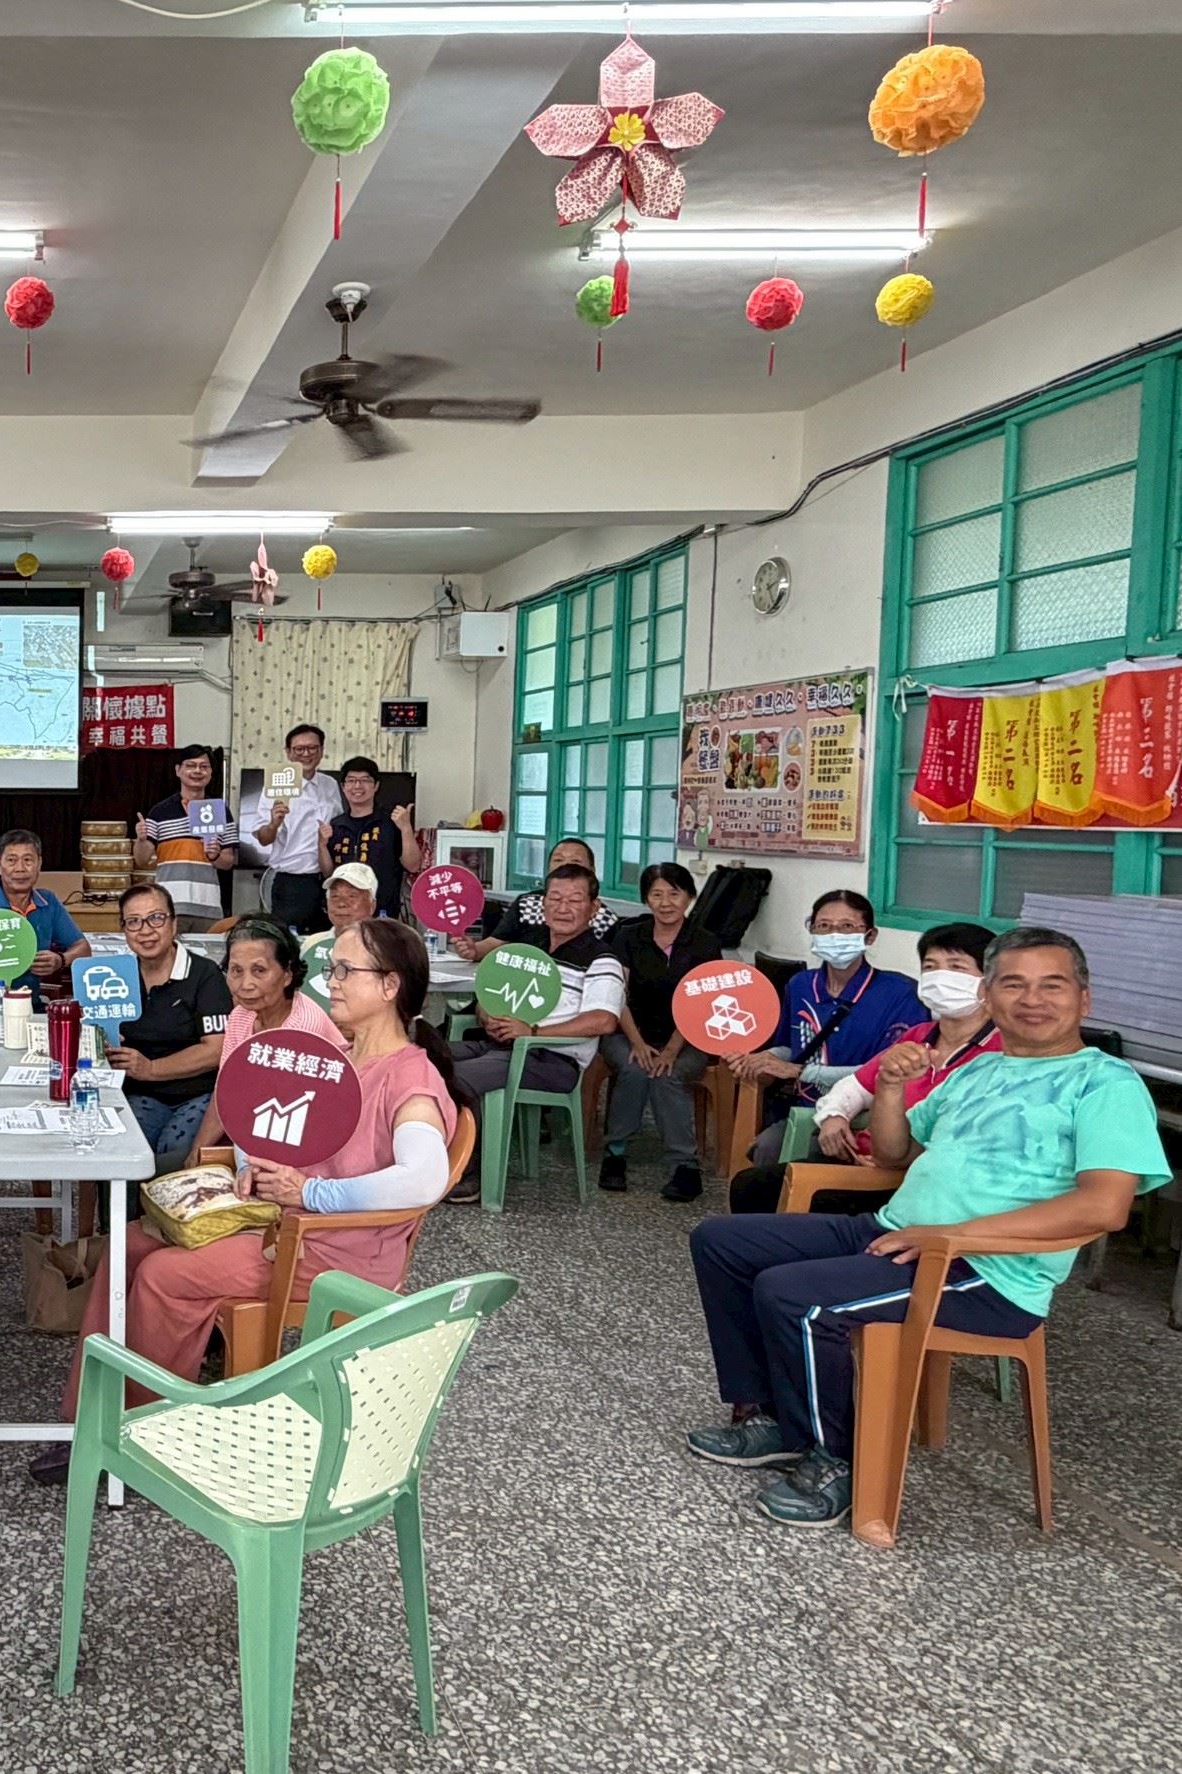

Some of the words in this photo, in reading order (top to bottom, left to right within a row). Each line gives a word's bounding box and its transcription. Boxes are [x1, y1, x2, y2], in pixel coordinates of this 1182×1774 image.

[82, 693, 166, 721] 關懷據點
[88, 723, 168, 747] 幸福共餐
[1067, 708, 1084, 786] 第二名
[1003, 719, 1019, 790] 第二名
[426, 881, 463, 900] 不平等
[495, 950, 552, 977] 健康福祉
[683, 968, 754, 997] 基礎建設
[80, 1003, 136, 1021] 交通運輸
[247, 1041, 345, 1084] 就業經濟
